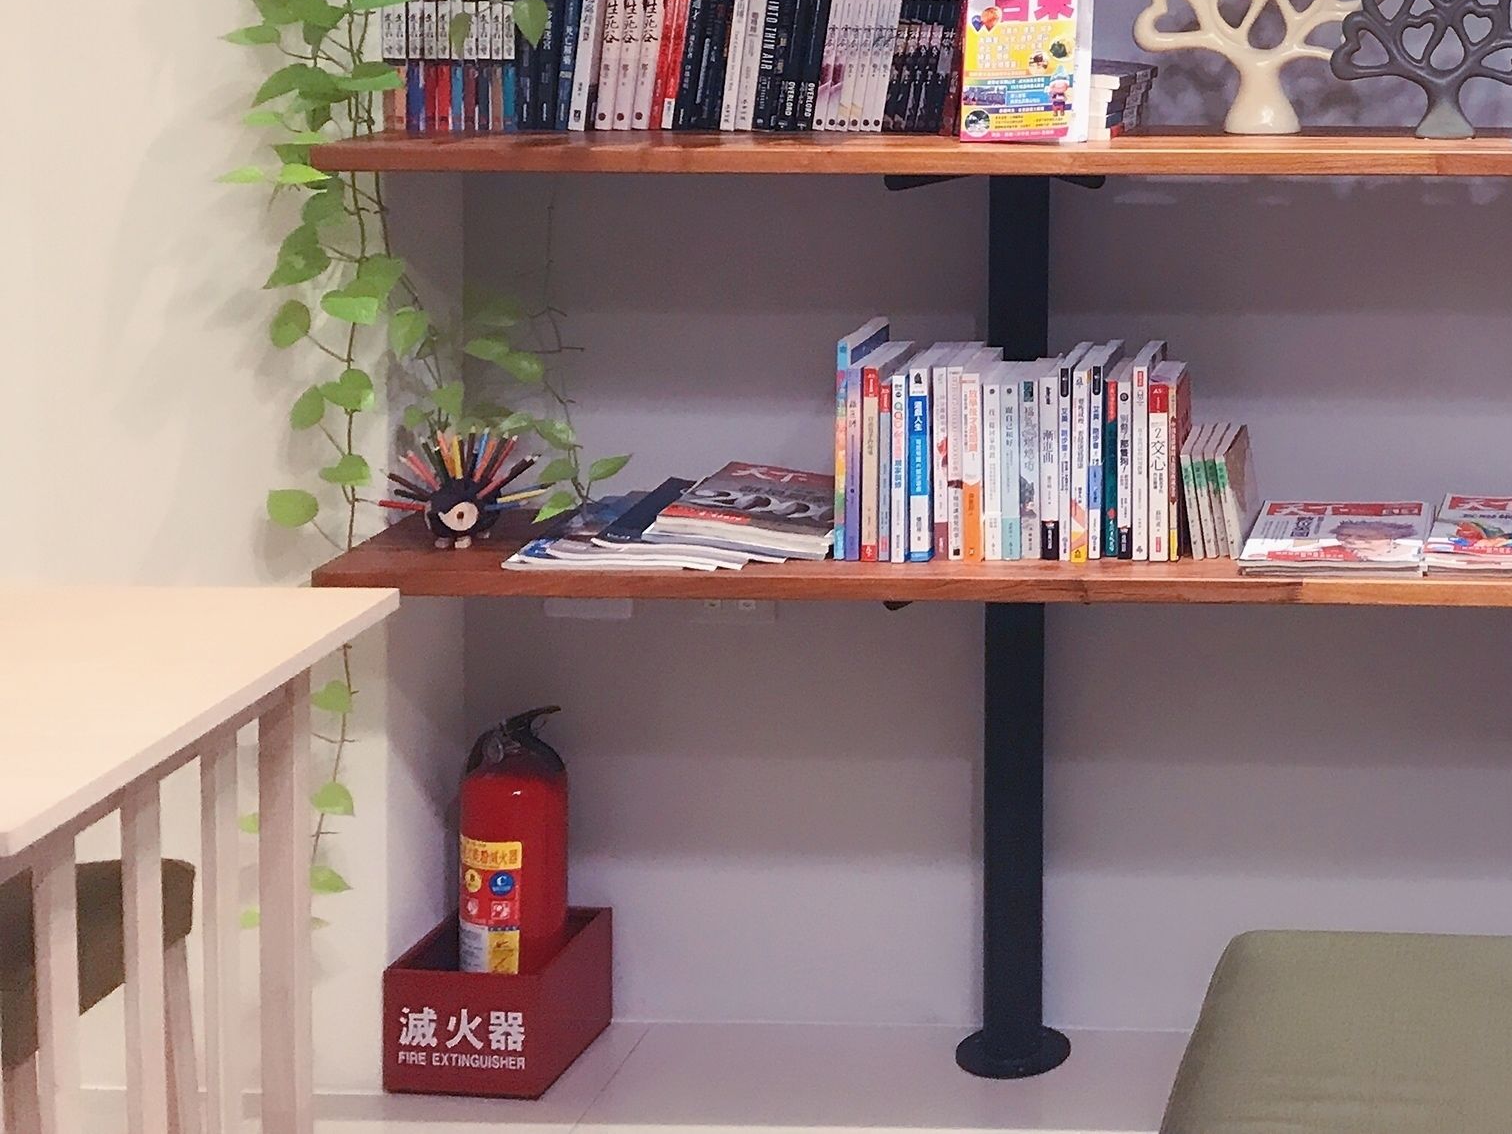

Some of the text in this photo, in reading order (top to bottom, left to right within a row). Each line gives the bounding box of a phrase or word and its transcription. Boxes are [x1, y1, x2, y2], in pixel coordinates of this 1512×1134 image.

[604, 0, 620, 43] 生死谷
[623, 0, 639, 43] 生死谷
[642, 0, 658, 43] 生死谷
[766, 0, 779, 23] INTO
[763, 28, 776, 51] THIN
[761, 54, 774, 70] AIR
[785, 81, 795, 116] OVERLORD
[805, 82, 815, 117] OVERLORD
[731, 468, 807, 483] 天下
[1274, 503, 1349, 515] 天下
[399, 1006, 525, 1051] 滅火器
[398, 1051, 525, 1070] FIRE EXTINGUISHER
